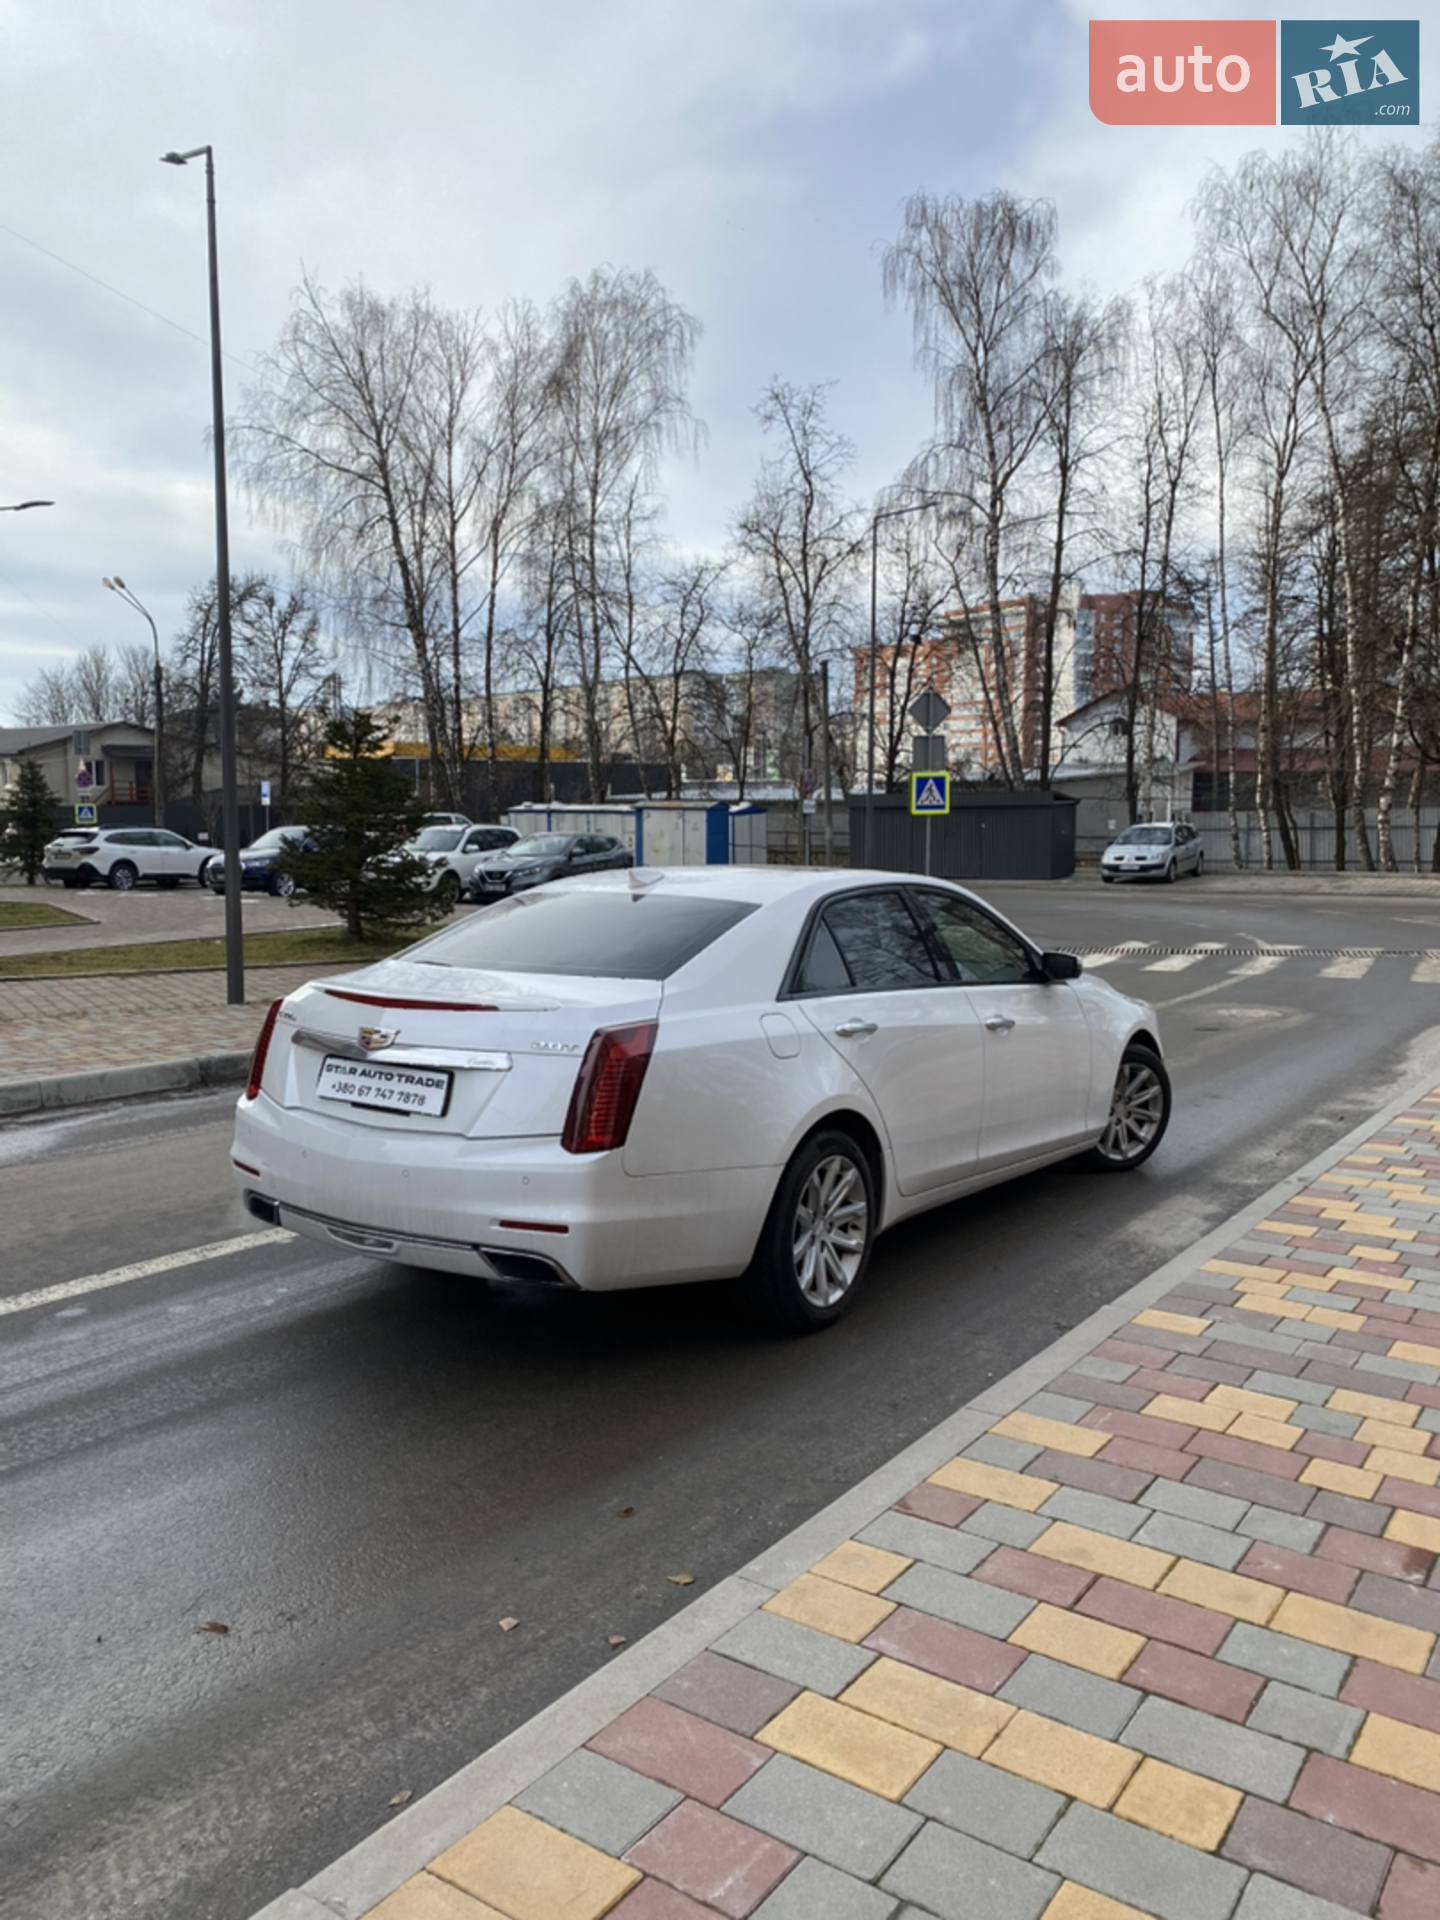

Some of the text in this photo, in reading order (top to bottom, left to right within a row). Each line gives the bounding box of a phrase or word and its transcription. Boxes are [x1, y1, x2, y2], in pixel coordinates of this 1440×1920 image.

[325, 1063, 445, 1090] STAR AUTO TRADE
[331, 1081, 427, 1106] +380 67 747 7878
